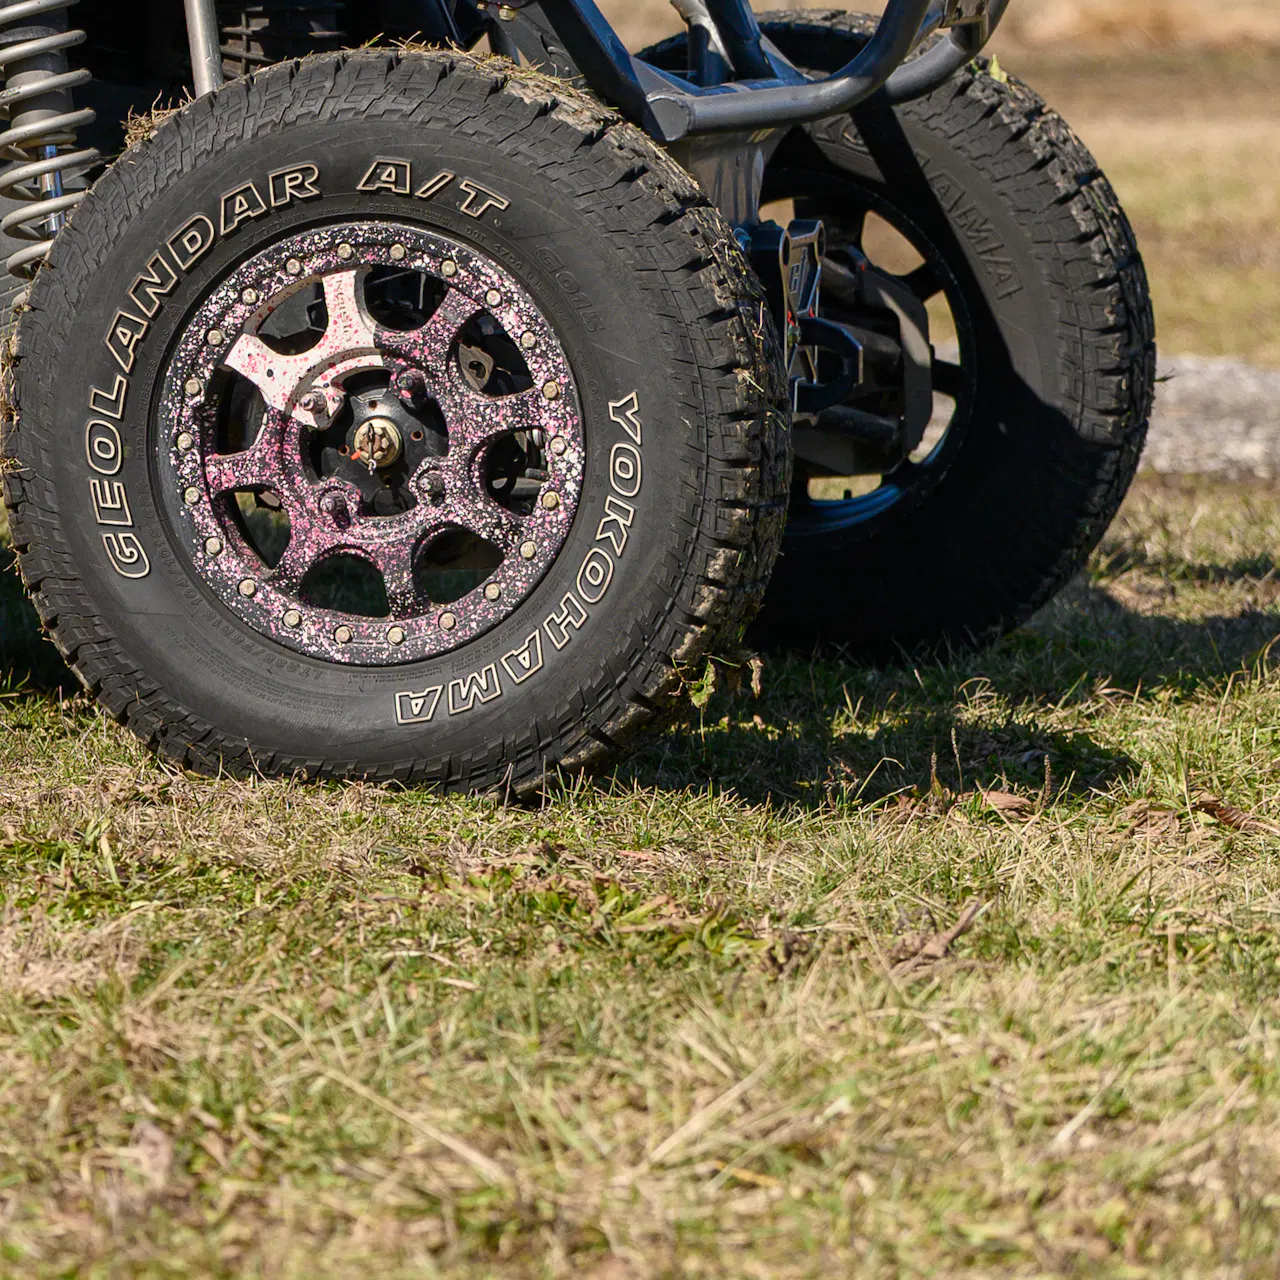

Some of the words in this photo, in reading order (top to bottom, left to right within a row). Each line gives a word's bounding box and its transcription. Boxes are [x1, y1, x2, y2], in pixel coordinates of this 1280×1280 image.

[86, 163, 322, 581] GEOLANDAR
[356, 159, 511, 221] A/T
[394, 391, 643, 725] YOKOHAMA
